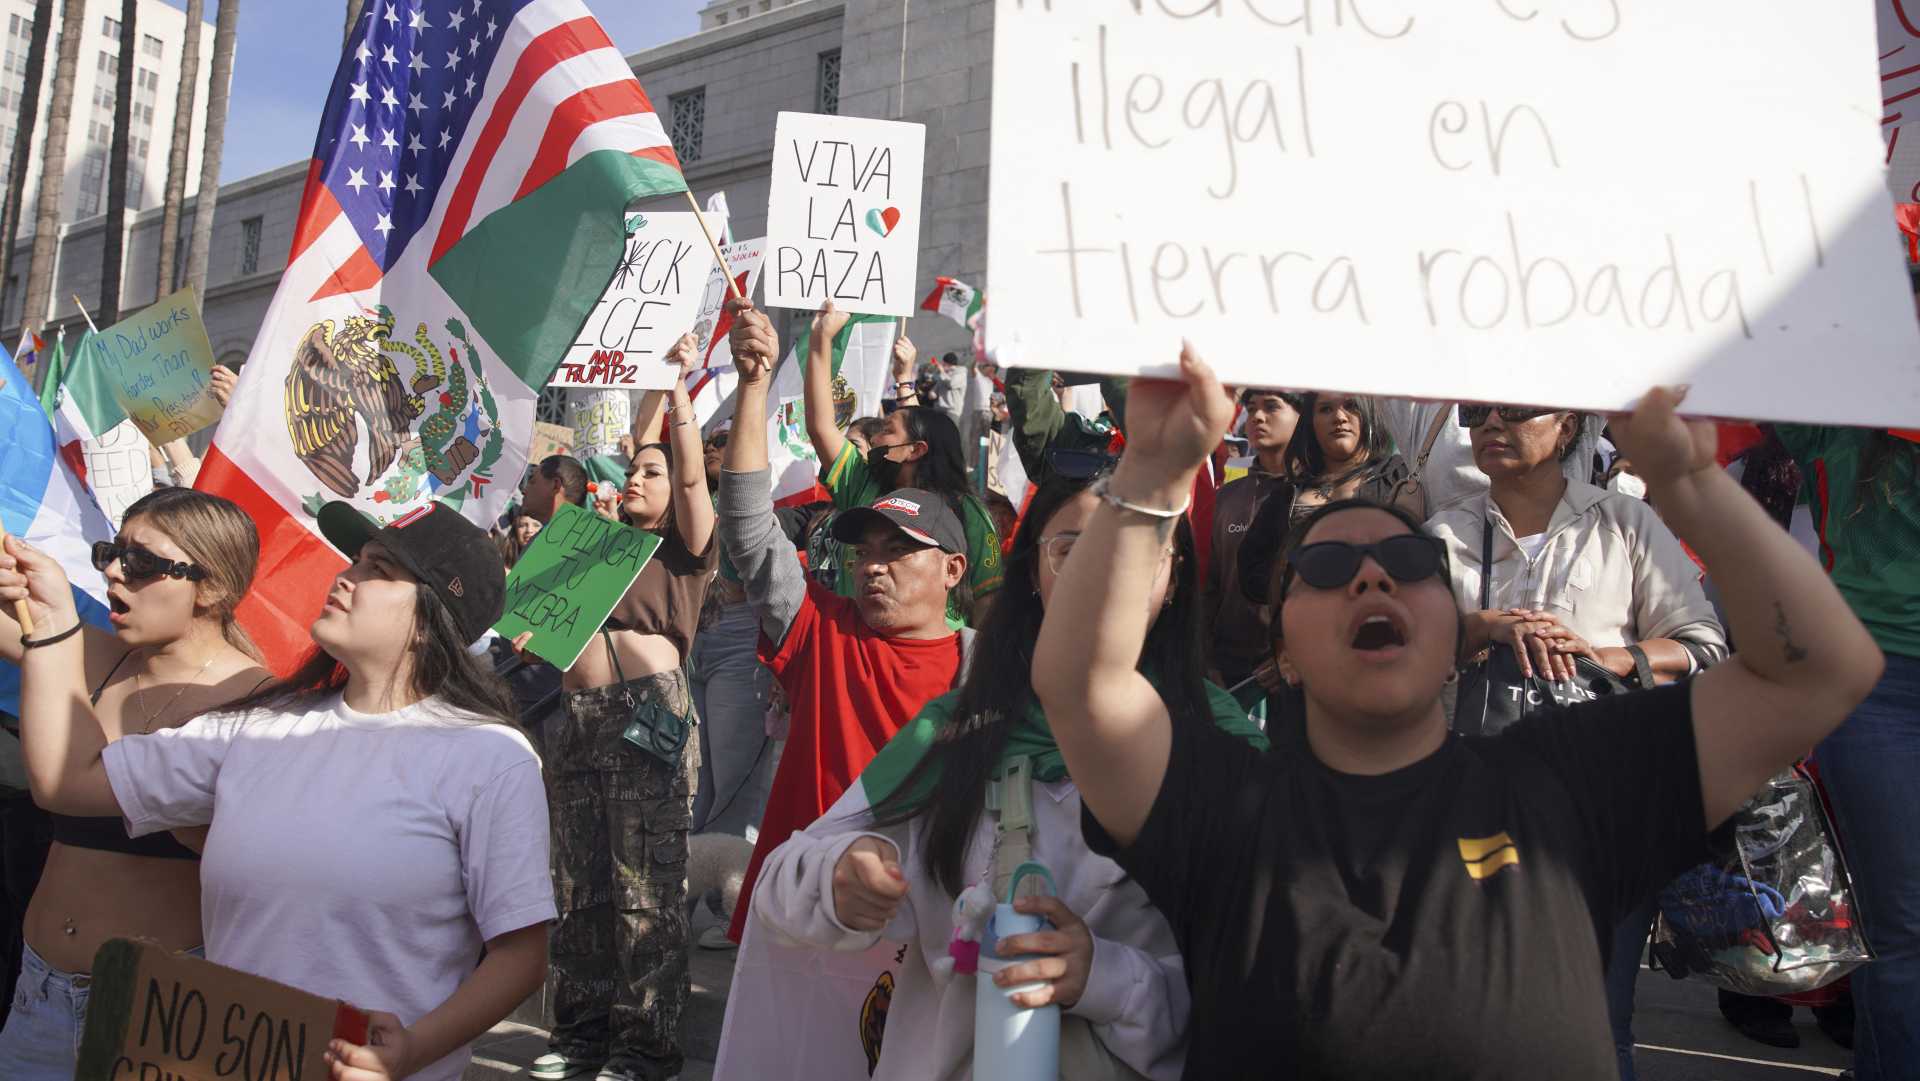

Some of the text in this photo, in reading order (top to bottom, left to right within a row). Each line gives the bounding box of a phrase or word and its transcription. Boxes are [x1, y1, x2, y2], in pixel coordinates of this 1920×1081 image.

[1070, 24, 1561, 200] ilegal en
[793, 138, 891, 200] VIVA
[807, 196, 857, 243] LA
[778, 246, 887, 305] RAZA
[1035, 181, 1370, 325] tierra
[95, 339, 124, 377] My
[116, 326, 147, 360] Dad
[588, 350, 625, 365] AND
[545, 509, 644, 572] CHINGA
[553, 554, 592, 590] TU
[506, 575, 582, 638] MIGRA
[140, 977, 306, 1081] NO SON
